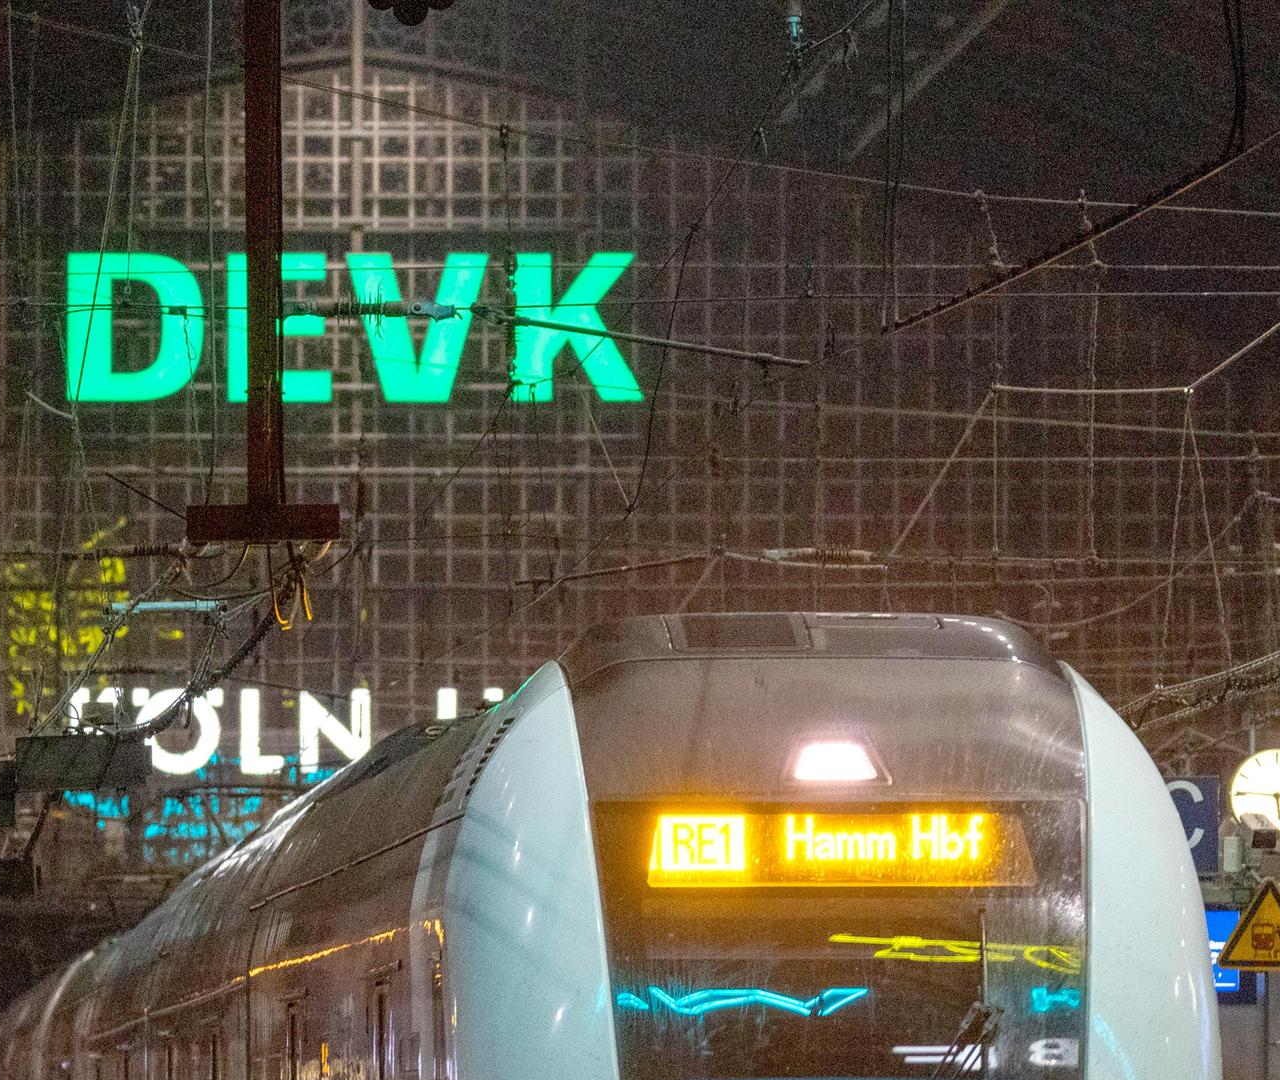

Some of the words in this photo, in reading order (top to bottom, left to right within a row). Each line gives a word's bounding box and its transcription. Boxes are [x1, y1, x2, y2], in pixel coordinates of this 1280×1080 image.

[67, 252, 644, 401] DEVK
[671, 821, 733, 865] RE1
[785, 814, 896, 860] Hamm
[911, 814, 985, 860] Hbf
